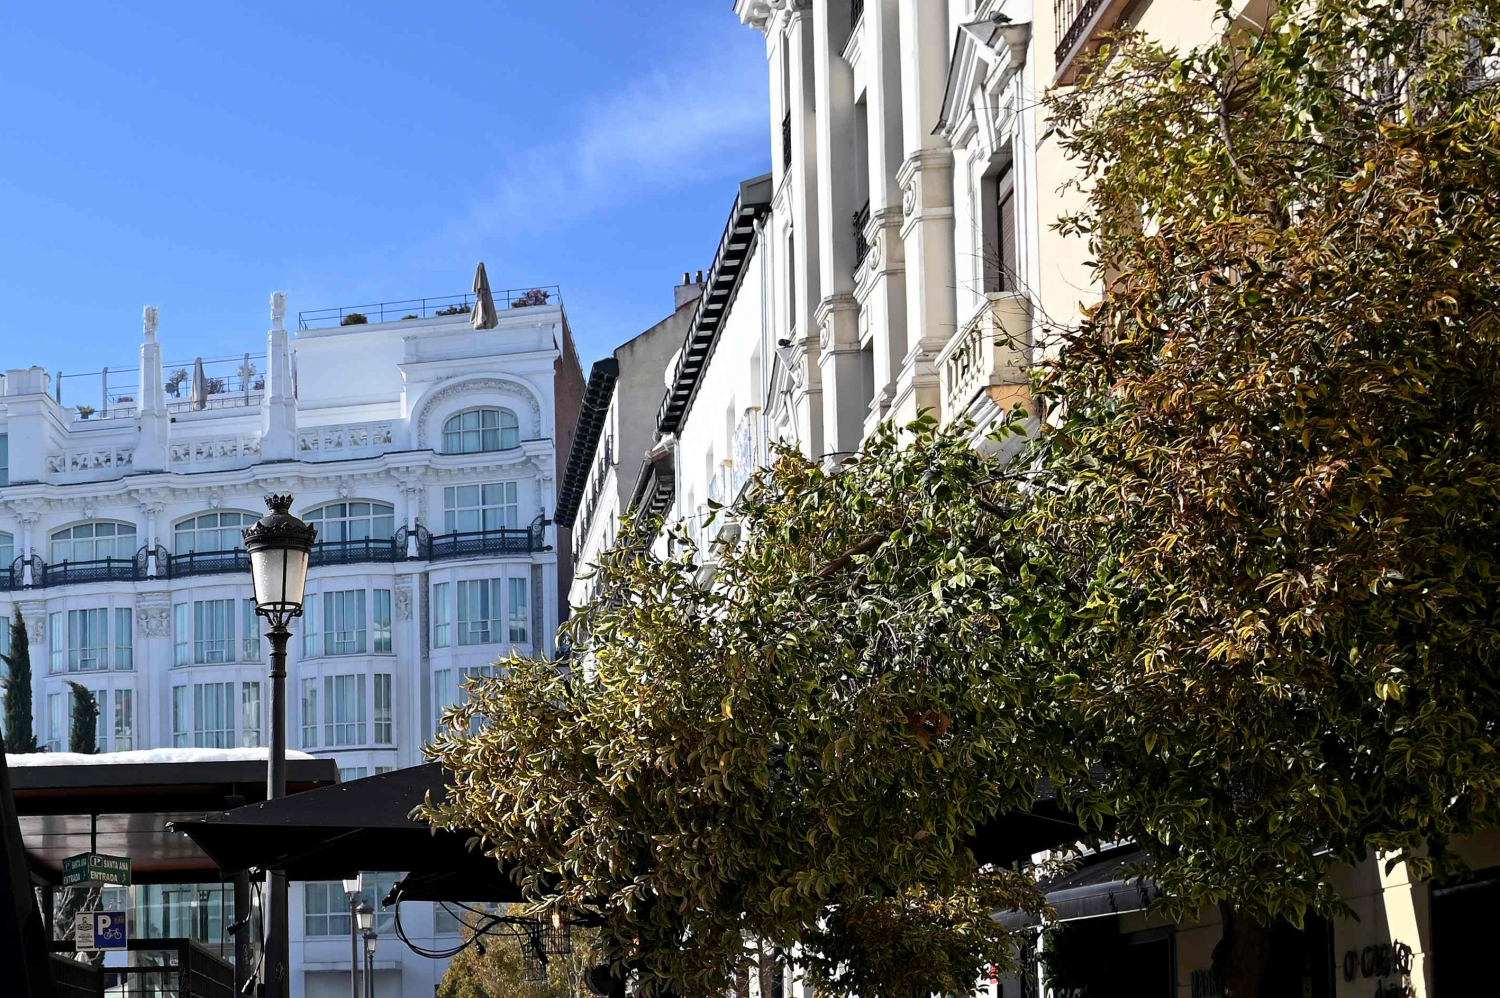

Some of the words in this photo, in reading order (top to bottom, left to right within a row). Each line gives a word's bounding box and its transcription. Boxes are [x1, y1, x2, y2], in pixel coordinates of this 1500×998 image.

[94, 858, 101, 866] P
[104, 860, 118, 870] SANTA
[119, 861, 129, 871] ANA
[63, 873, 80, 885] ENTRADA
[90, 871, 118, 882] ENTRADA
[98, 915, 111, 936] P
